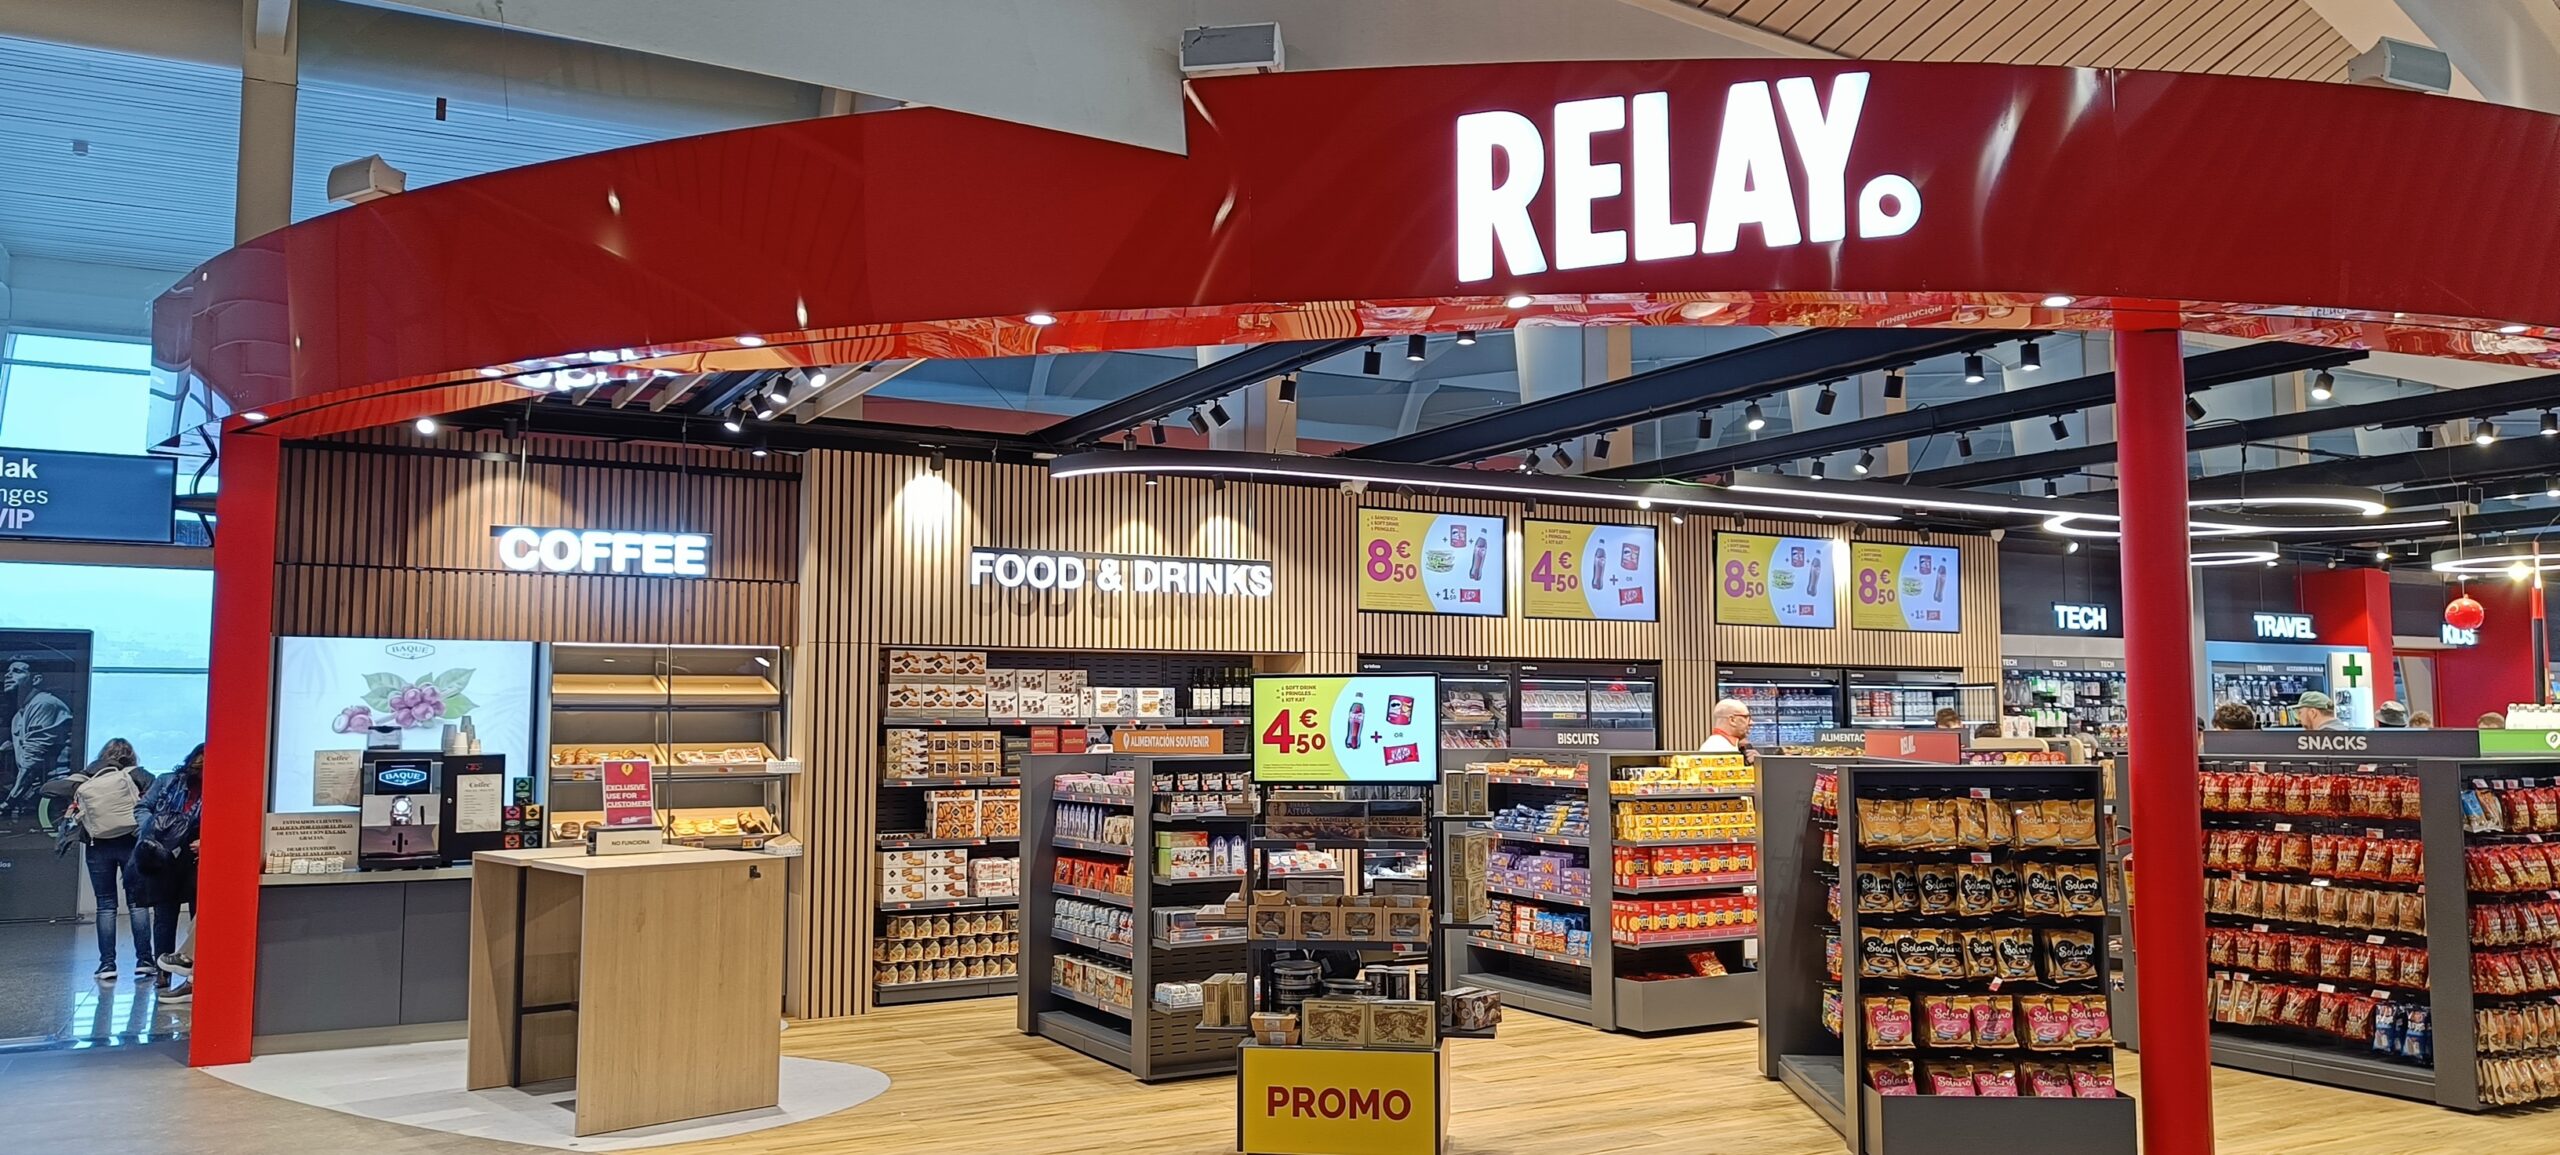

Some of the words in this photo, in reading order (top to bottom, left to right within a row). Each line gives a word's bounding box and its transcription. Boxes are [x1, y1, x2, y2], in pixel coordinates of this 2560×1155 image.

[1457, 71, 1870, 283] RELAY
[499, 527, 707, 575] COFFEE
[971, 551, 1085, 589] FOOD
[1096, 558, 1122, 591] &
[1134, 560, 1273, 596] DRINKS
[2054, 605, 2107, 630] TECH
[2253, 615, 2317, 639] TRAVEL
[2100, 660, 2115, 668] TECH
[1130, 733, 1175, 747] ALIMENTACIÓN
[1176, 736, 1209, 747] SOUVENIR
[1557, 733, 1600, 745] BISCUITS
[2297, 735, 2367, 751] SNACKS
[385, 772, 420, 780] BAQUE
[1267, 1086, 1412, 1121] PROMO
